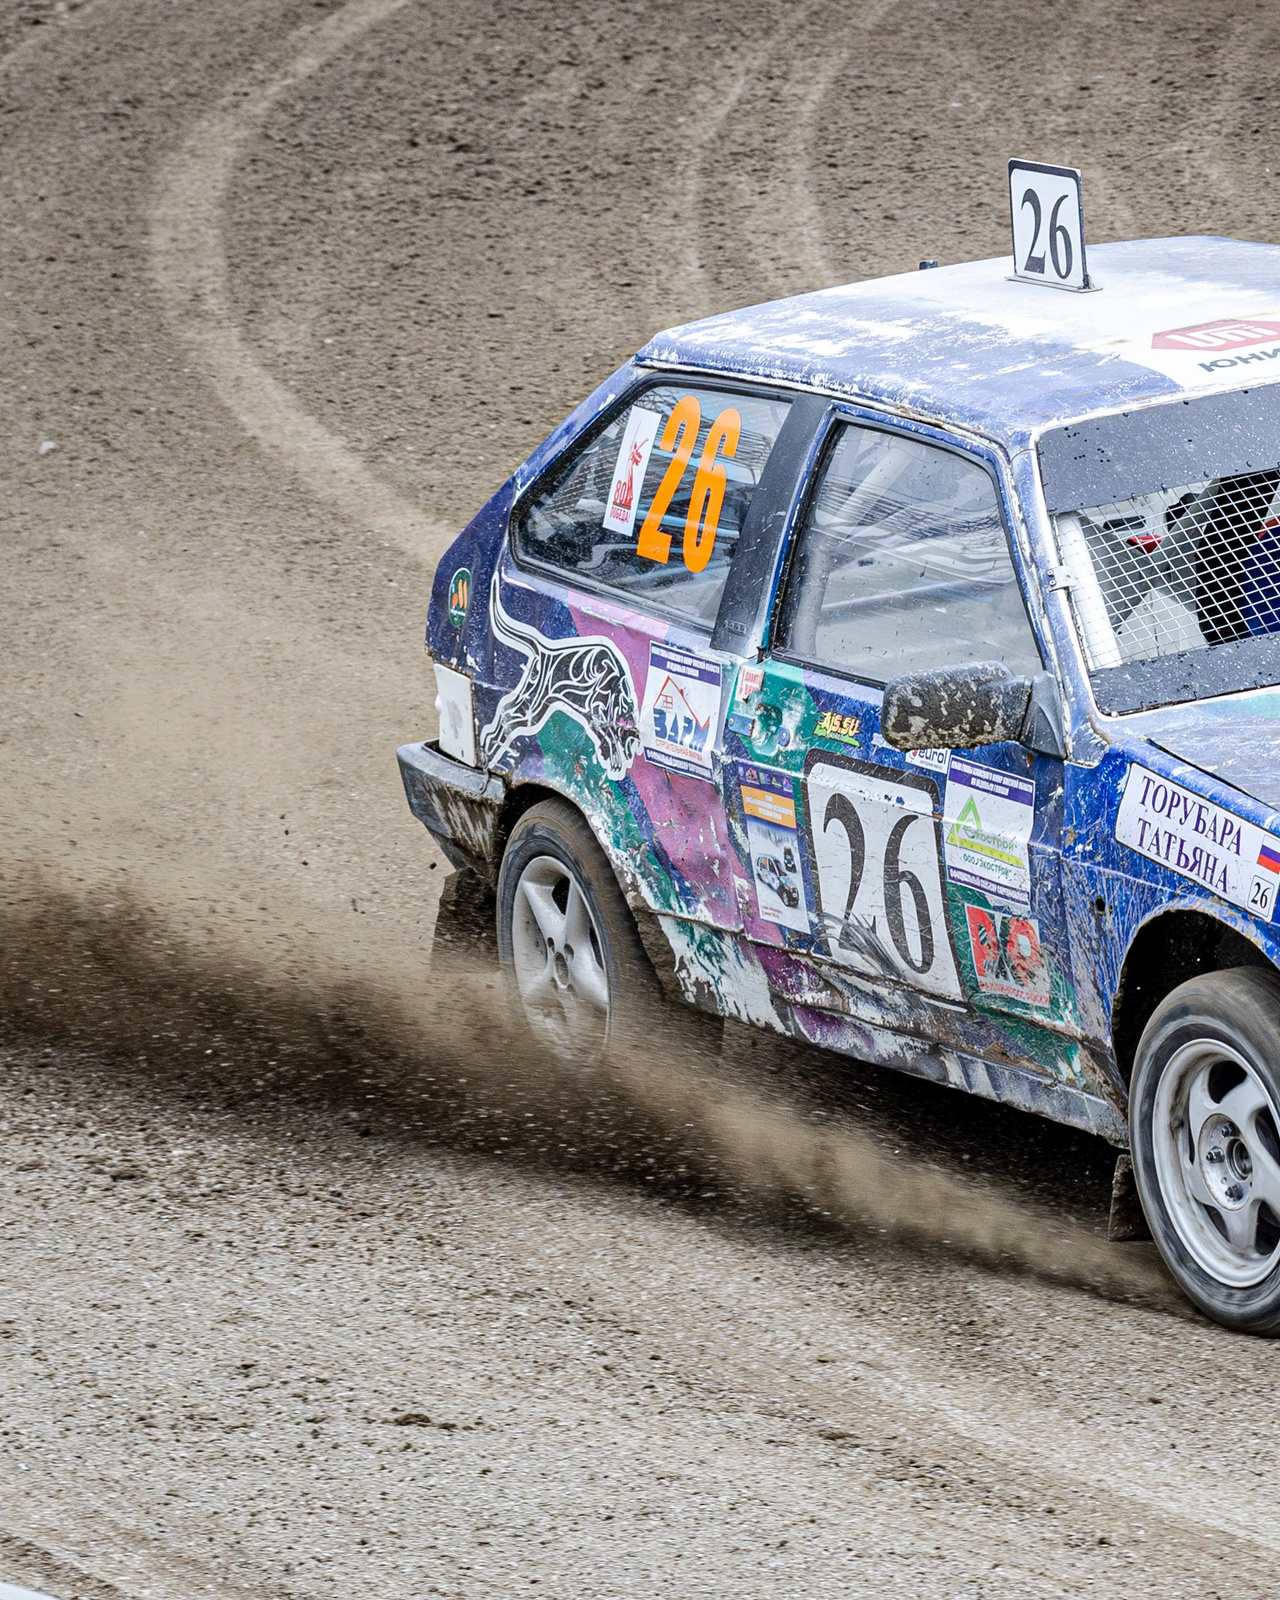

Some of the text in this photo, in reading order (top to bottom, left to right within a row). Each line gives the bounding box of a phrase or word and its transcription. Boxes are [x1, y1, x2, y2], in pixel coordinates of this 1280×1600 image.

[1021, 188, 1073, 280] 26
[636, 395, 741, 573] 26
[918, 748, 948, 765] eurol
[1137, 817, 1229, 894] ТАТЬЯНА
[1139, 775, 1242, 857] ТОРУБАРА
[823, 792, 935, 974] 26
[1251, 881, 1272, 909] 26
